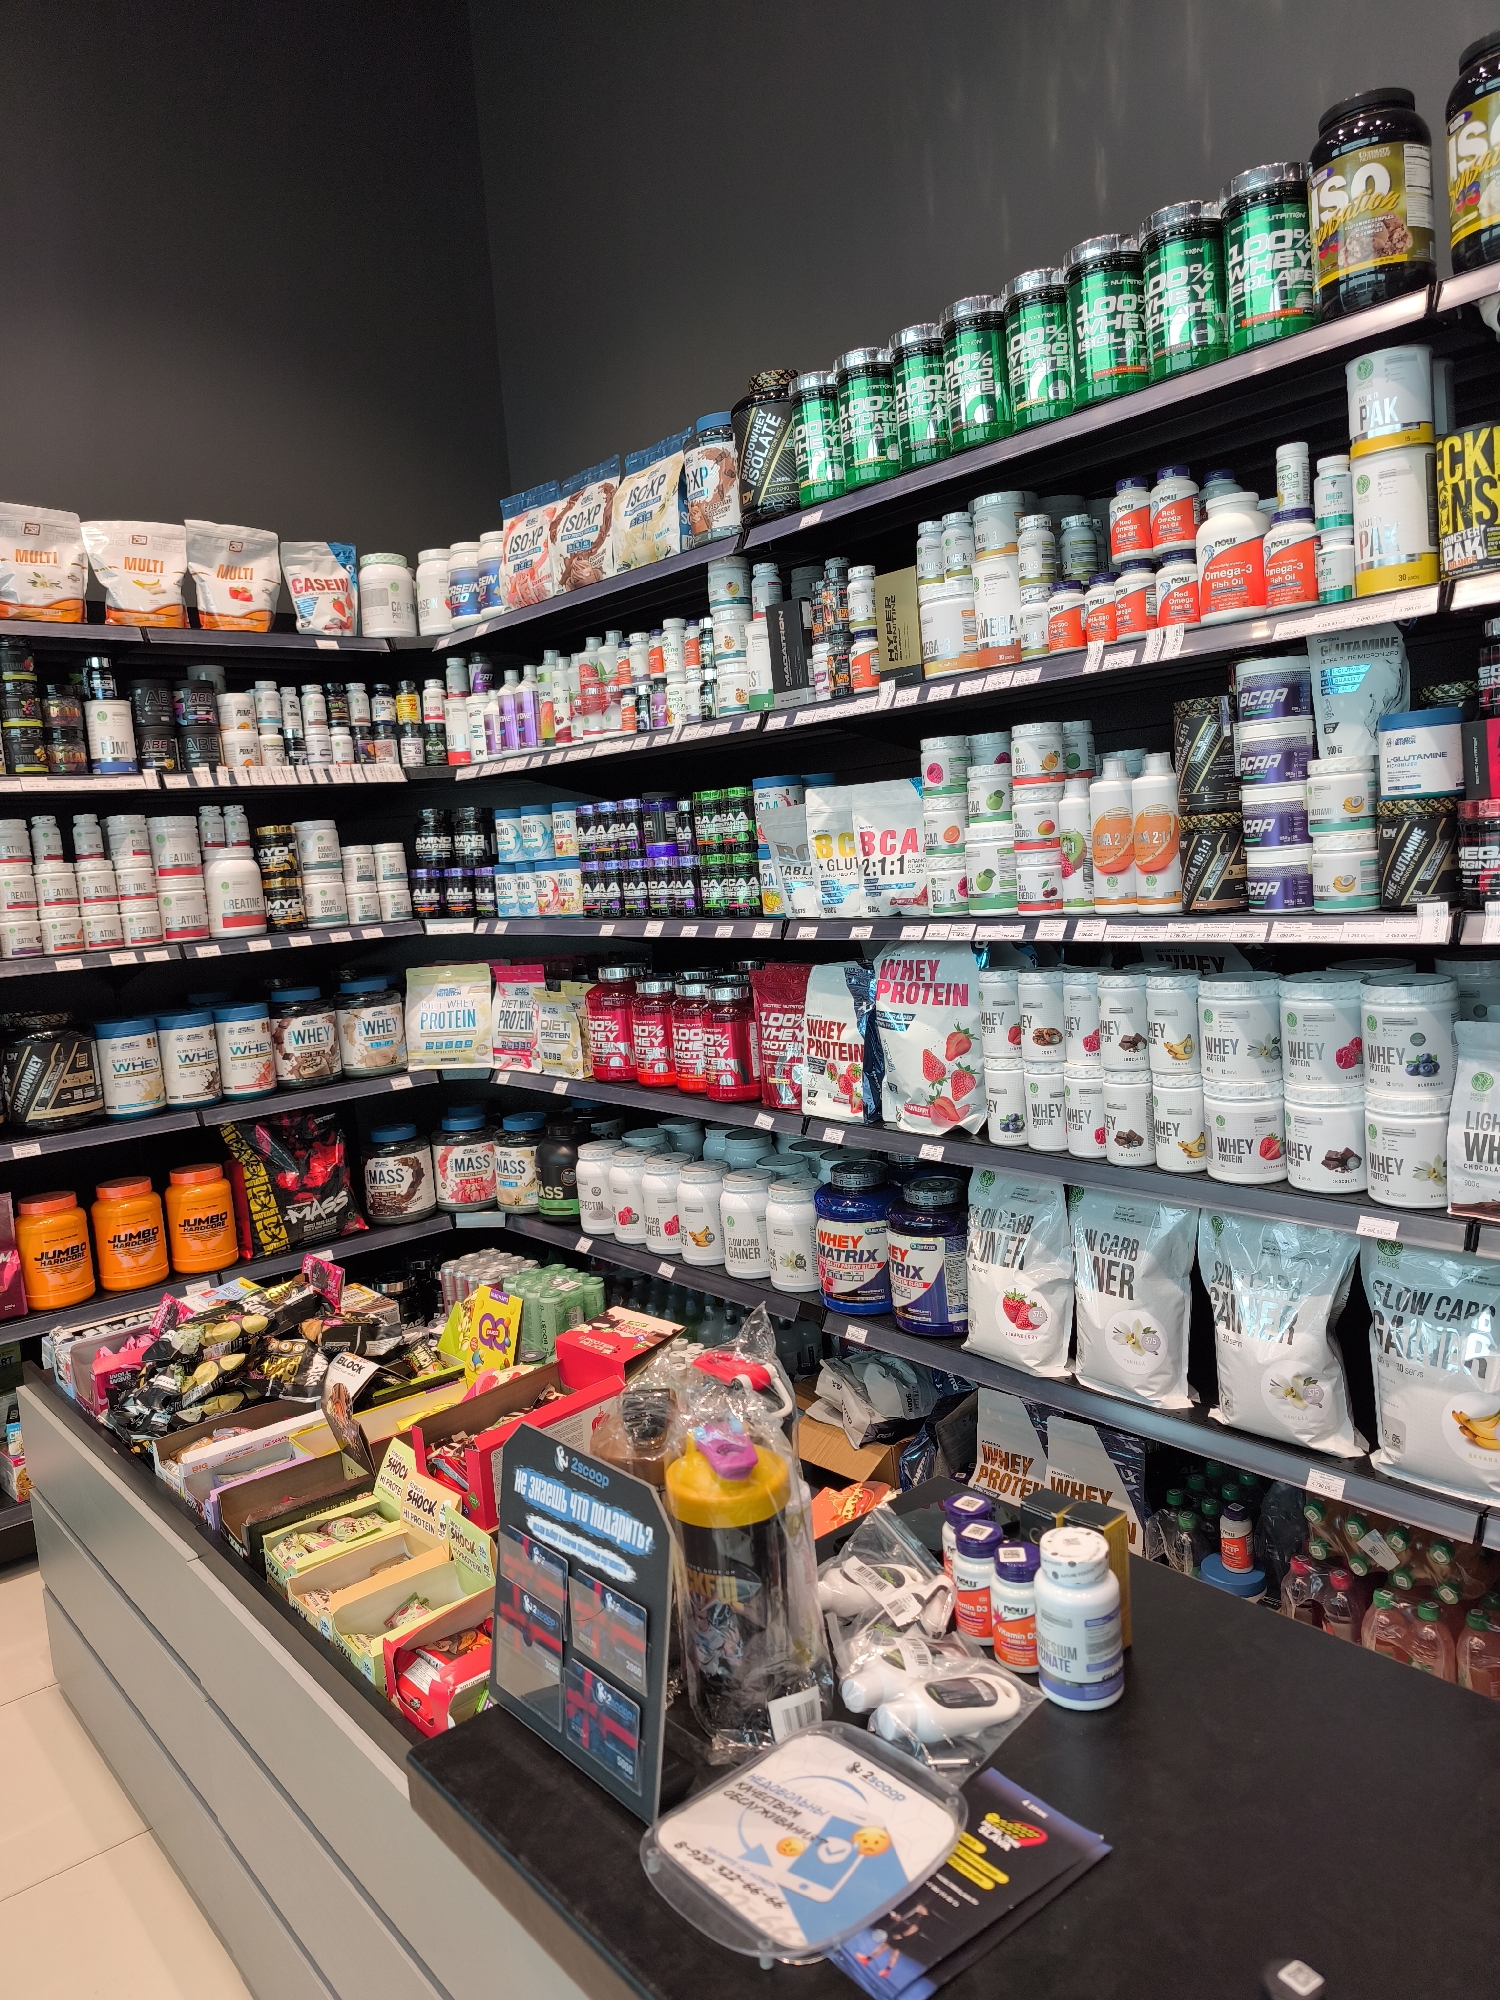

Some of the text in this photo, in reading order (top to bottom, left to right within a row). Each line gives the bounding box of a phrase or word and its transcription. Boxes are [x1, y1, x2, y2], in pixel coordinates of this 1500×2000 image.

[1311, 162, 1390, 231] ISO
[1229, 251, 1311, 284] WHEY
[1358, 396, 1399, 431] PAK
[742, 408, 767, 481] SHADOWHEY
[747, 412, 782, 487] ISOLATE
[1214, 536, 1237, 548] now
[1358, 522, 1401, 560] PAK
[1442, 526, 1484, 550] MONSTER
[15, 549, 58, 565] MULTI
[1442, 534, 1487, 571] PAK
[124, 556, 164, 574] MULTI
[216, 563, 254, 582] MULTI
[1204, 565, 1253, 582] Omega-3
[291, 577, 349, 596] CASEIN
[1211, 577, 1244, 589] Fish Oil
[1283, 573, 1296, 582] Oil
[1398, 573, 1407, 582] 30
[1320, 637, 1399, 656] GLUTAMINE
[1239, 687, 1288, 706] BCAA
[1240, 753, 1282, 772] BCAA
[1386, 751, 1448, 764] L-GLUTAMINE
[1383, 827, 1398, 840] DY
[158, 851, 196, 863] CREATINE
[1192, 839, 1212, 866] 10:1:1
[863, 855, 905, 877] 2:1:1
[1384, 826, 1427, 900] THE GLUTAMINE
[82, 885, 112, 895] CREATINE
[413, 888, 440, 896] ALL
[223, 897, 261, 910] CREATINE
[165, 915, 203, 926] CREATINE
[88, 929, 117, 939] CREATINE
[879, 959, 941, 982] WHEY
[876, 979, 969, 1007] PROTEIN
[447, 999, 475, 1008] WHEY
[362, 1017, 398, 1036] WHEY
[420, 1009, 476, 1030] PROTEIN
[540, 1019, 570, 1031] DIET
[291, 1026, 331, 1045] WHEY
[807, 1018, 847, 1041] WHEY
[230, 1041, 272, 1055] WHEY
[807, 1037, 864, 1062] PROTEIN
[1204, 1035, 1239, 1055] WHEY
[1288, 1040, 1325, 1061] WHEY
[177, 1050, 218, 1064] WHEY
[1206, 1053, 1227, 1063] PROTEIN
[1289, 1058, 1311, 1068] PROTEIN
[1367, 1043, 1406, 1066] WHEY
[112, 1058, 159, 1073] WHEY
[1369, 1063, 1391, 1073] PROTEIN
[14, 1054, 44, 1113] SHADOWHEY
[1031, 1103, 1062, 1118] WHEY
[1216, 1137, 1255, 1155] WHEY
[454, 1154, 491, 1172] MASS
[1218, 1153, 1243, 1164] PROTEIN
[1369, 1154, 1404, 1176] WHEY
[368, 1168, 405, 1185] MASS
[1370, 1172, 1389, 1182] PROTEIN
[284, 1191, 349, 1225] MASS
[178, 1211, 228, 1228] JUMBO
[183, 1220, 226, 1233] HARDCORE
[107, 1226, 159, 1244] JUMBO
[112, 1234, 157, 1250] HARDCORE
[817, 1234, 864, 1249] WHEY
[34, 1241, 87, 1262] JUMBO
[728, 1246, 761, 1260] GAINER
[1100, 1230, 1140, 1262] CARB
[40, 1251, 85, 1267] HARDCORE
[1373, 1280, 1432, 1316] SLOW
[1032, 1310, 1043, 1319] 375
[1145, 1336, 1157, 1345] 375
[336, 1356, 363, 1375] BLOCK
[1307, 1388, 1320, 1397] 375
[1283, 1413, 1310, 1422] VANILLA
[191, 1462, 208, 1473] BIG
[982, 1444, 1035, 1477] WHEY
[1468, 1453, 1498, 1464] BANANA
[570, 1457, 610, 1489] 2scoop
[406, 1489, 438, 1518] SHOCK
[403, 1509, 436, 1536] HI PROTEIN
[528, 1475, 568, 1514] знаешь
[570, 1494, 590, 1522] что
[590, 1506, 654, 1552] подарить?
[956, 1576, 978, 1588] now
[976, 1604, 988, 1612] D3
[1003, 1605, 1029, 1615] now
[997, 1626, 1026, 1641] Vitamin
[616, 1755, 633, 1776] 5000
[862, 1770, 906, 1802] 2scoop
[735, 1781, 803, 1818] КАЧЕСТВОМ
[746, 1773, 831, 1818] НЕДОВОЛЬНЫ
